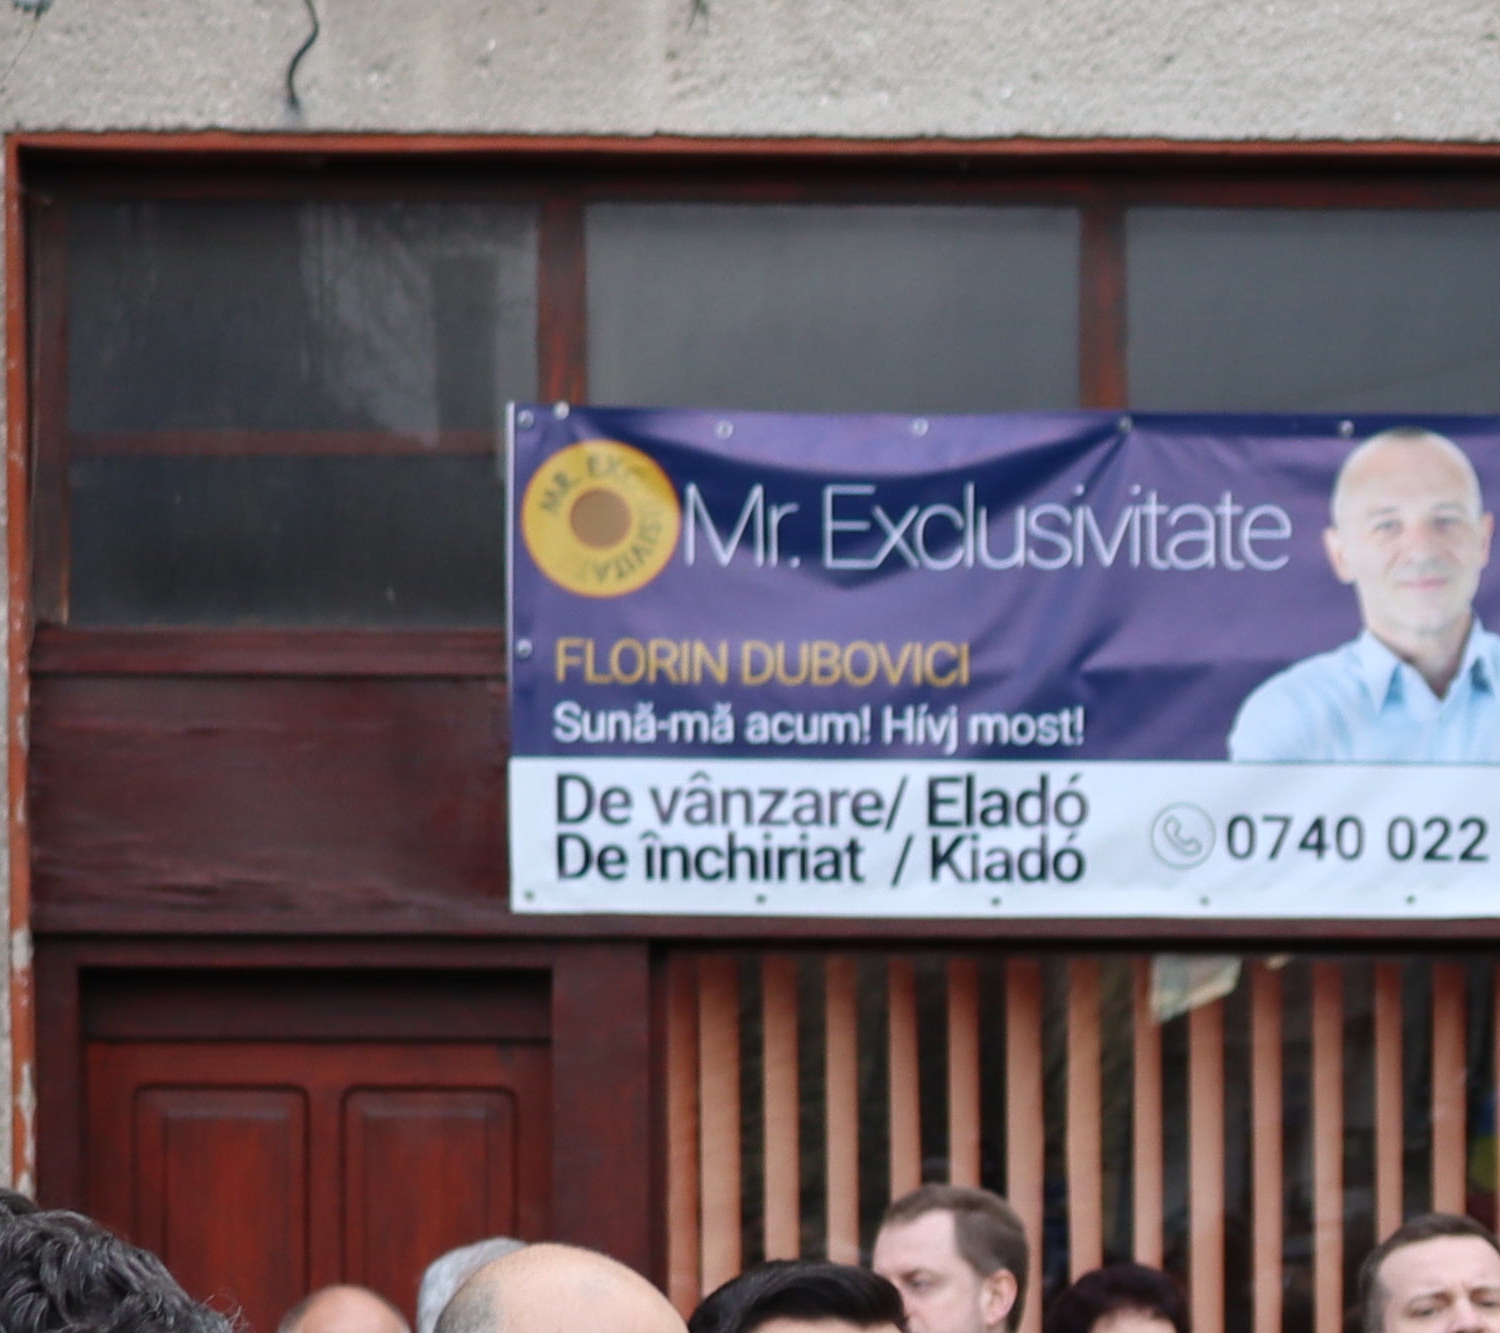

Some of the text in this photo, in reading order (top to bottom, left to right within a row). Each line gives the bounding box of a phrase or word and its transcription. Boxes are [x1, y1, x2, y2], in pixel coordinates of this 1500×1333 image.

[684, 482, 1294, 571] Mr. Exclusivitate
[555, 638, 970, 686] FLORIN DUBOVICI
[553, 701, 1085, 756] Sună-mă acum! Hívj most!
[555, 772, 633, 826] De
[926, 773, 1090, 829] Eladó
[555, 833, 628, 882] De
[638, 830, 865, 883] închiriat
[930, 834, 1087, 884] Kiadó
[1225, 813, 1366, 862] 0740
[1386, 815, 1490, 863] 022
